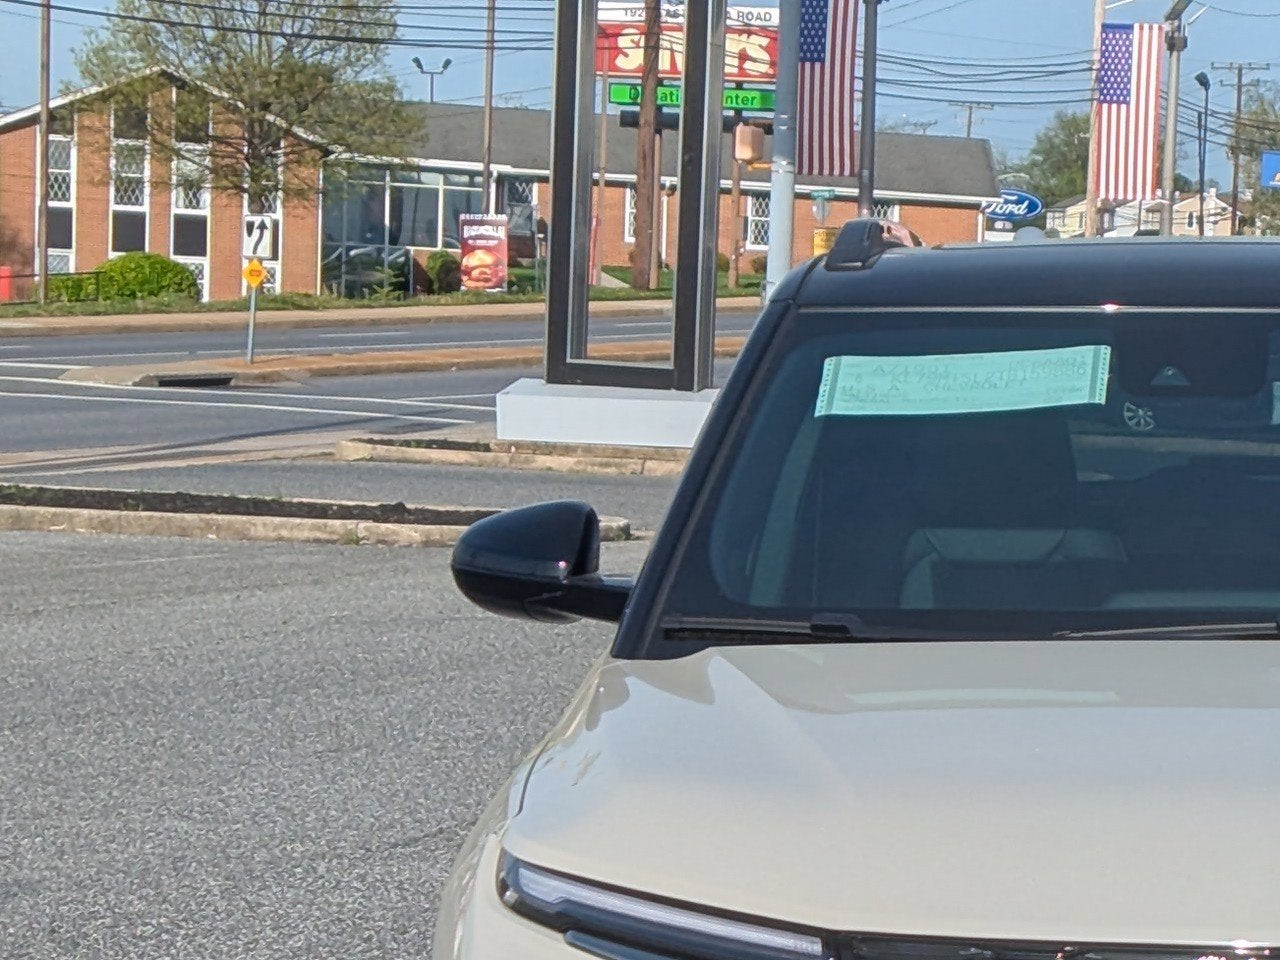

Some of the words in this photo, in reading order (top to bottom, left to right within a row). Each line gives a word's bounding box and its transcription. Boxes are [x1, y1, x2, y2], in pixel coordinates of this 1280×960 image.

[736, 10, 772, 23] ROAD
[724, 92, 757, 107] nter
[985, 194, 1030, 215] Ford
